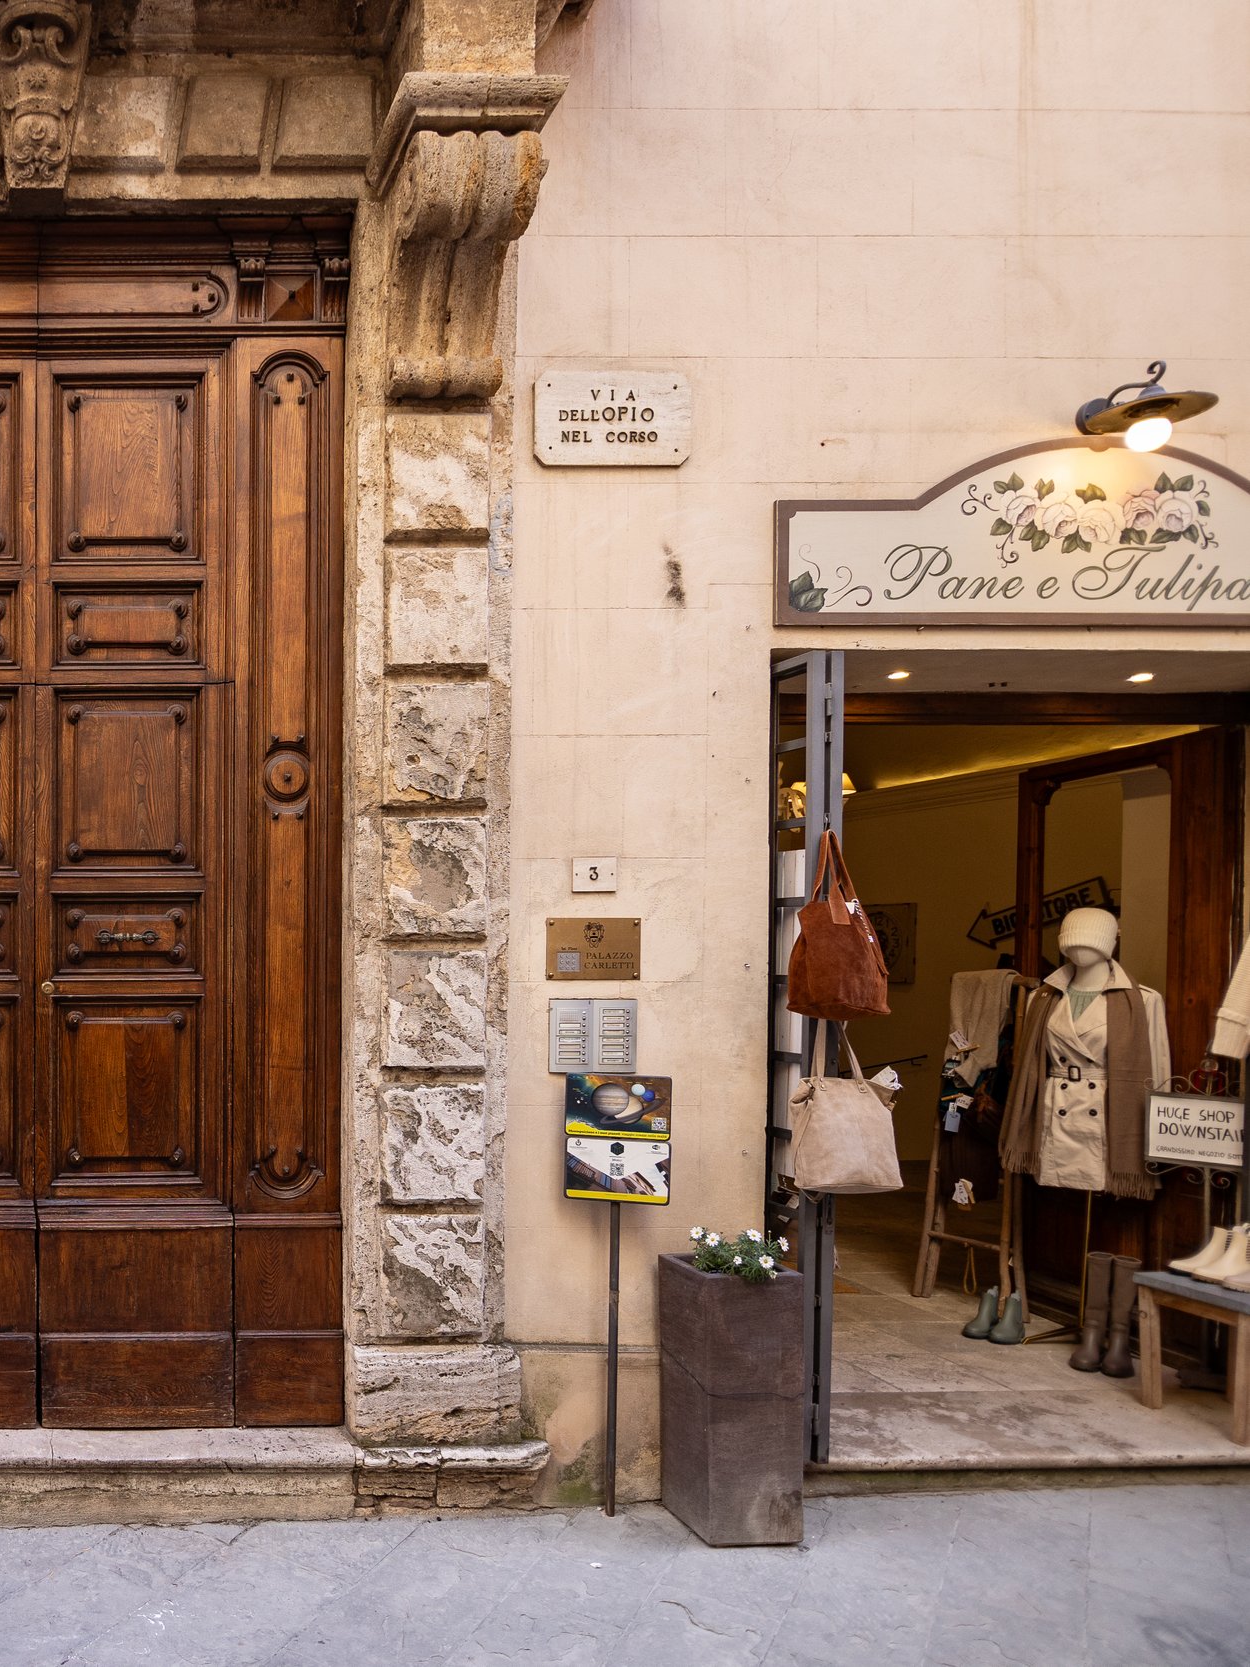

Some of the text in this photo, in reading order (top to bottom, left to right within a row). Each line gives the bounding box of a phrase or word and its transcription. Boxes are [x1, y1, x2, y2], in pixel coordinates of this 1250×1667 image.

[591, 389, 636, 401] VIA
[561, 430, 658, 443] NEL CORSO
[883, 544, 1025, 600] Pane
[1036, 576, 1060, 599] e
[589, 866, 599, 881] 3
[1042, 887, 1095, 918] TORE
[586, 952, 634, 960] PALAZZO
[584, 961, 635, 969] CARLETTI
[1157, 1106, 1235, 1123] HUGE SHOP
[1156, 1145, 1196, 1155] GRANDISSIMO
[1198, 1149, 1226, 1158] NEGOZIO
